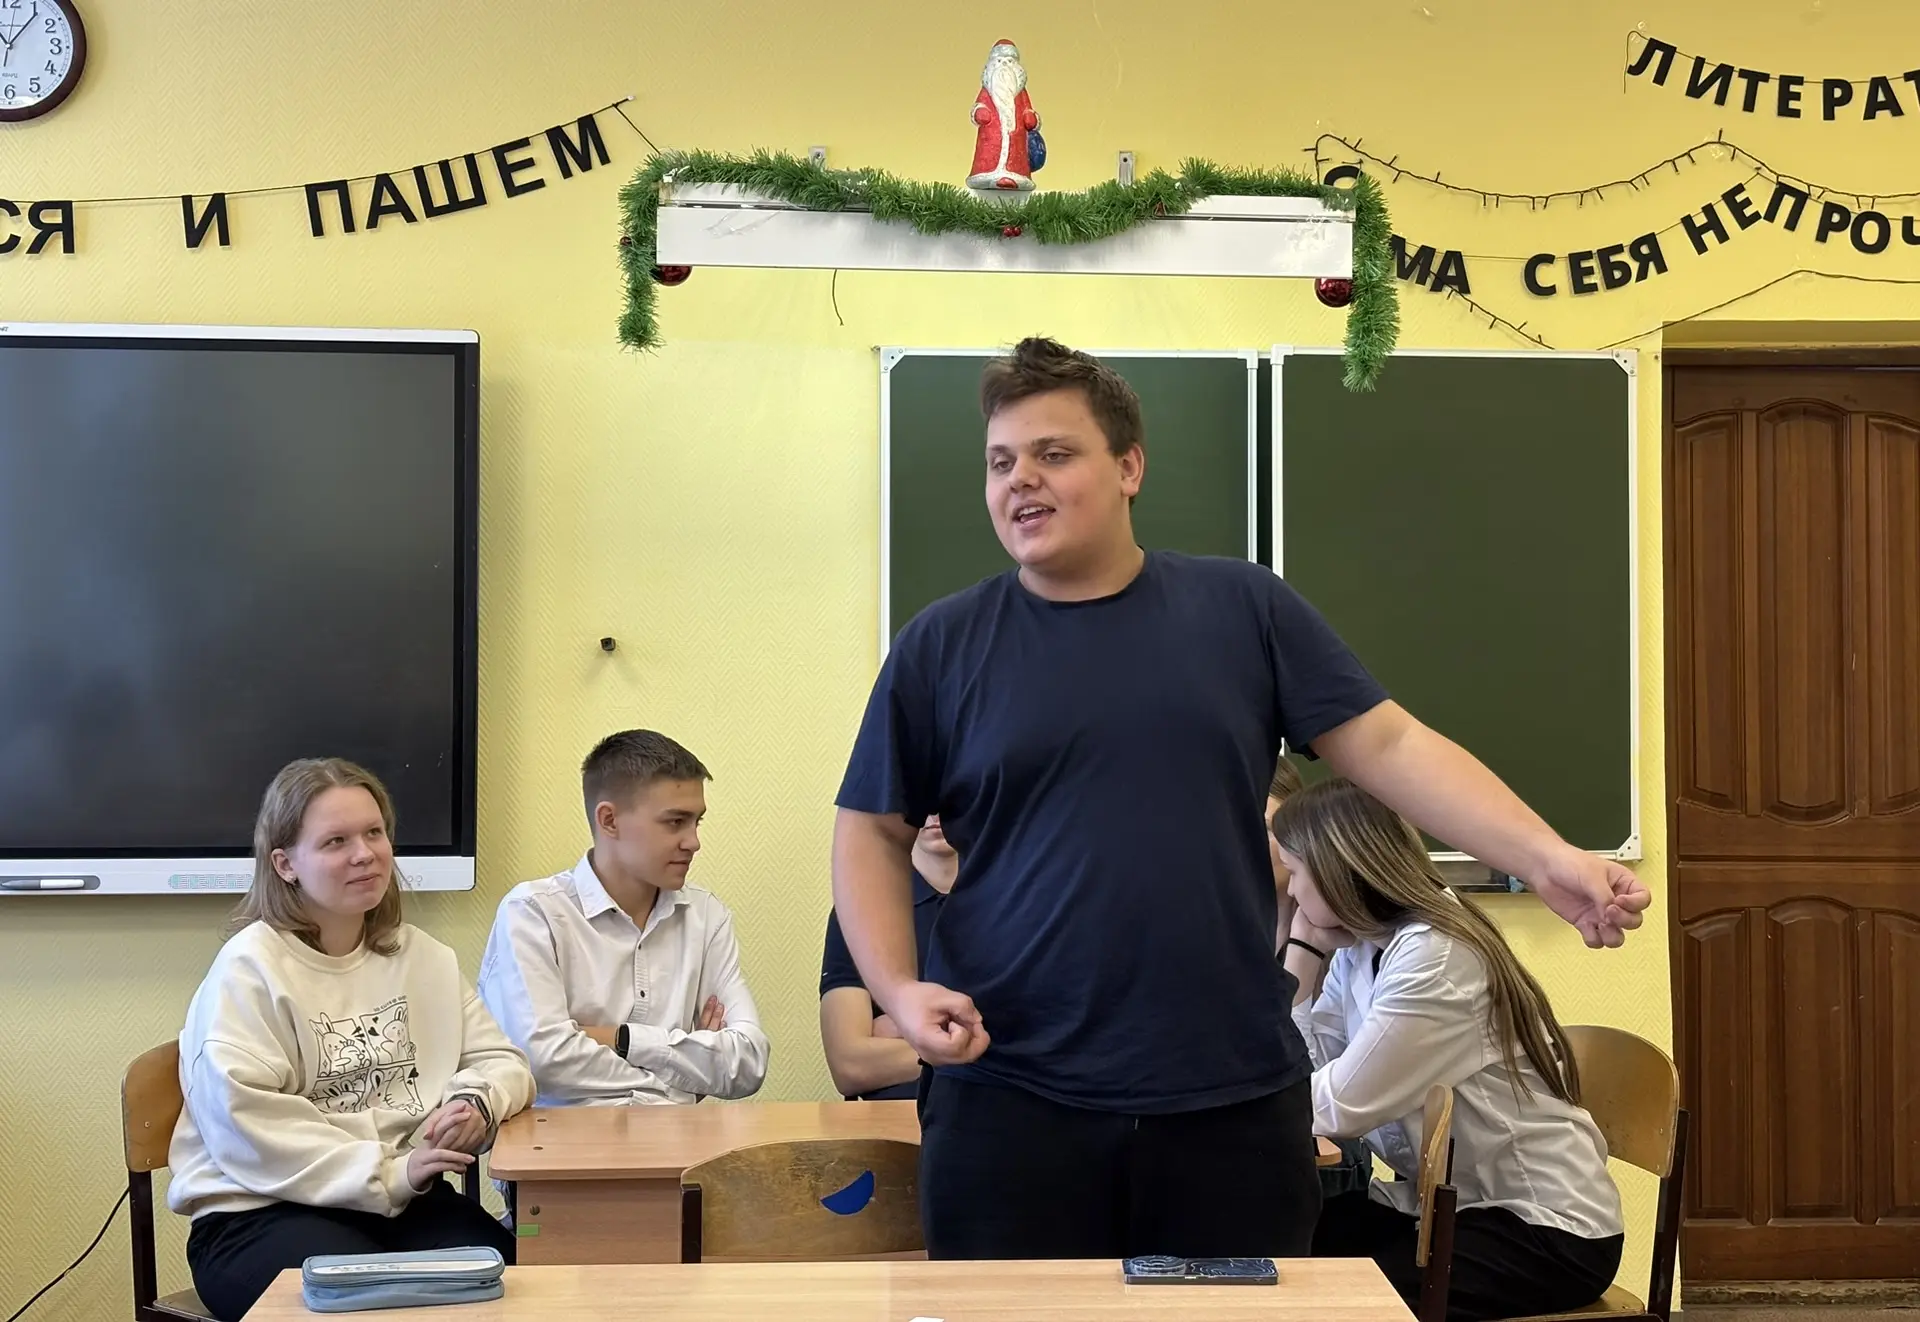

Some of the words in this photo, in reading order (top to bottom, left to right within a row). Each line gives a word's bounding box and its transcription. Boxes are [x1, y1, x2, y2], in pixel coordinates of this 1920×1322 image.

[45, 18, 56, 34] 2
[49, 37, 62, 55] 3
[44, 59, 57, 75] 4
[4, 84, 16, 99] 6
[29, 76, 41, 93] 5
[181, 192, 231, 249] И
[305, 114, 611, 238] ПАШЕМ
[1524, 231, 1669, 296] СЕБЯ
